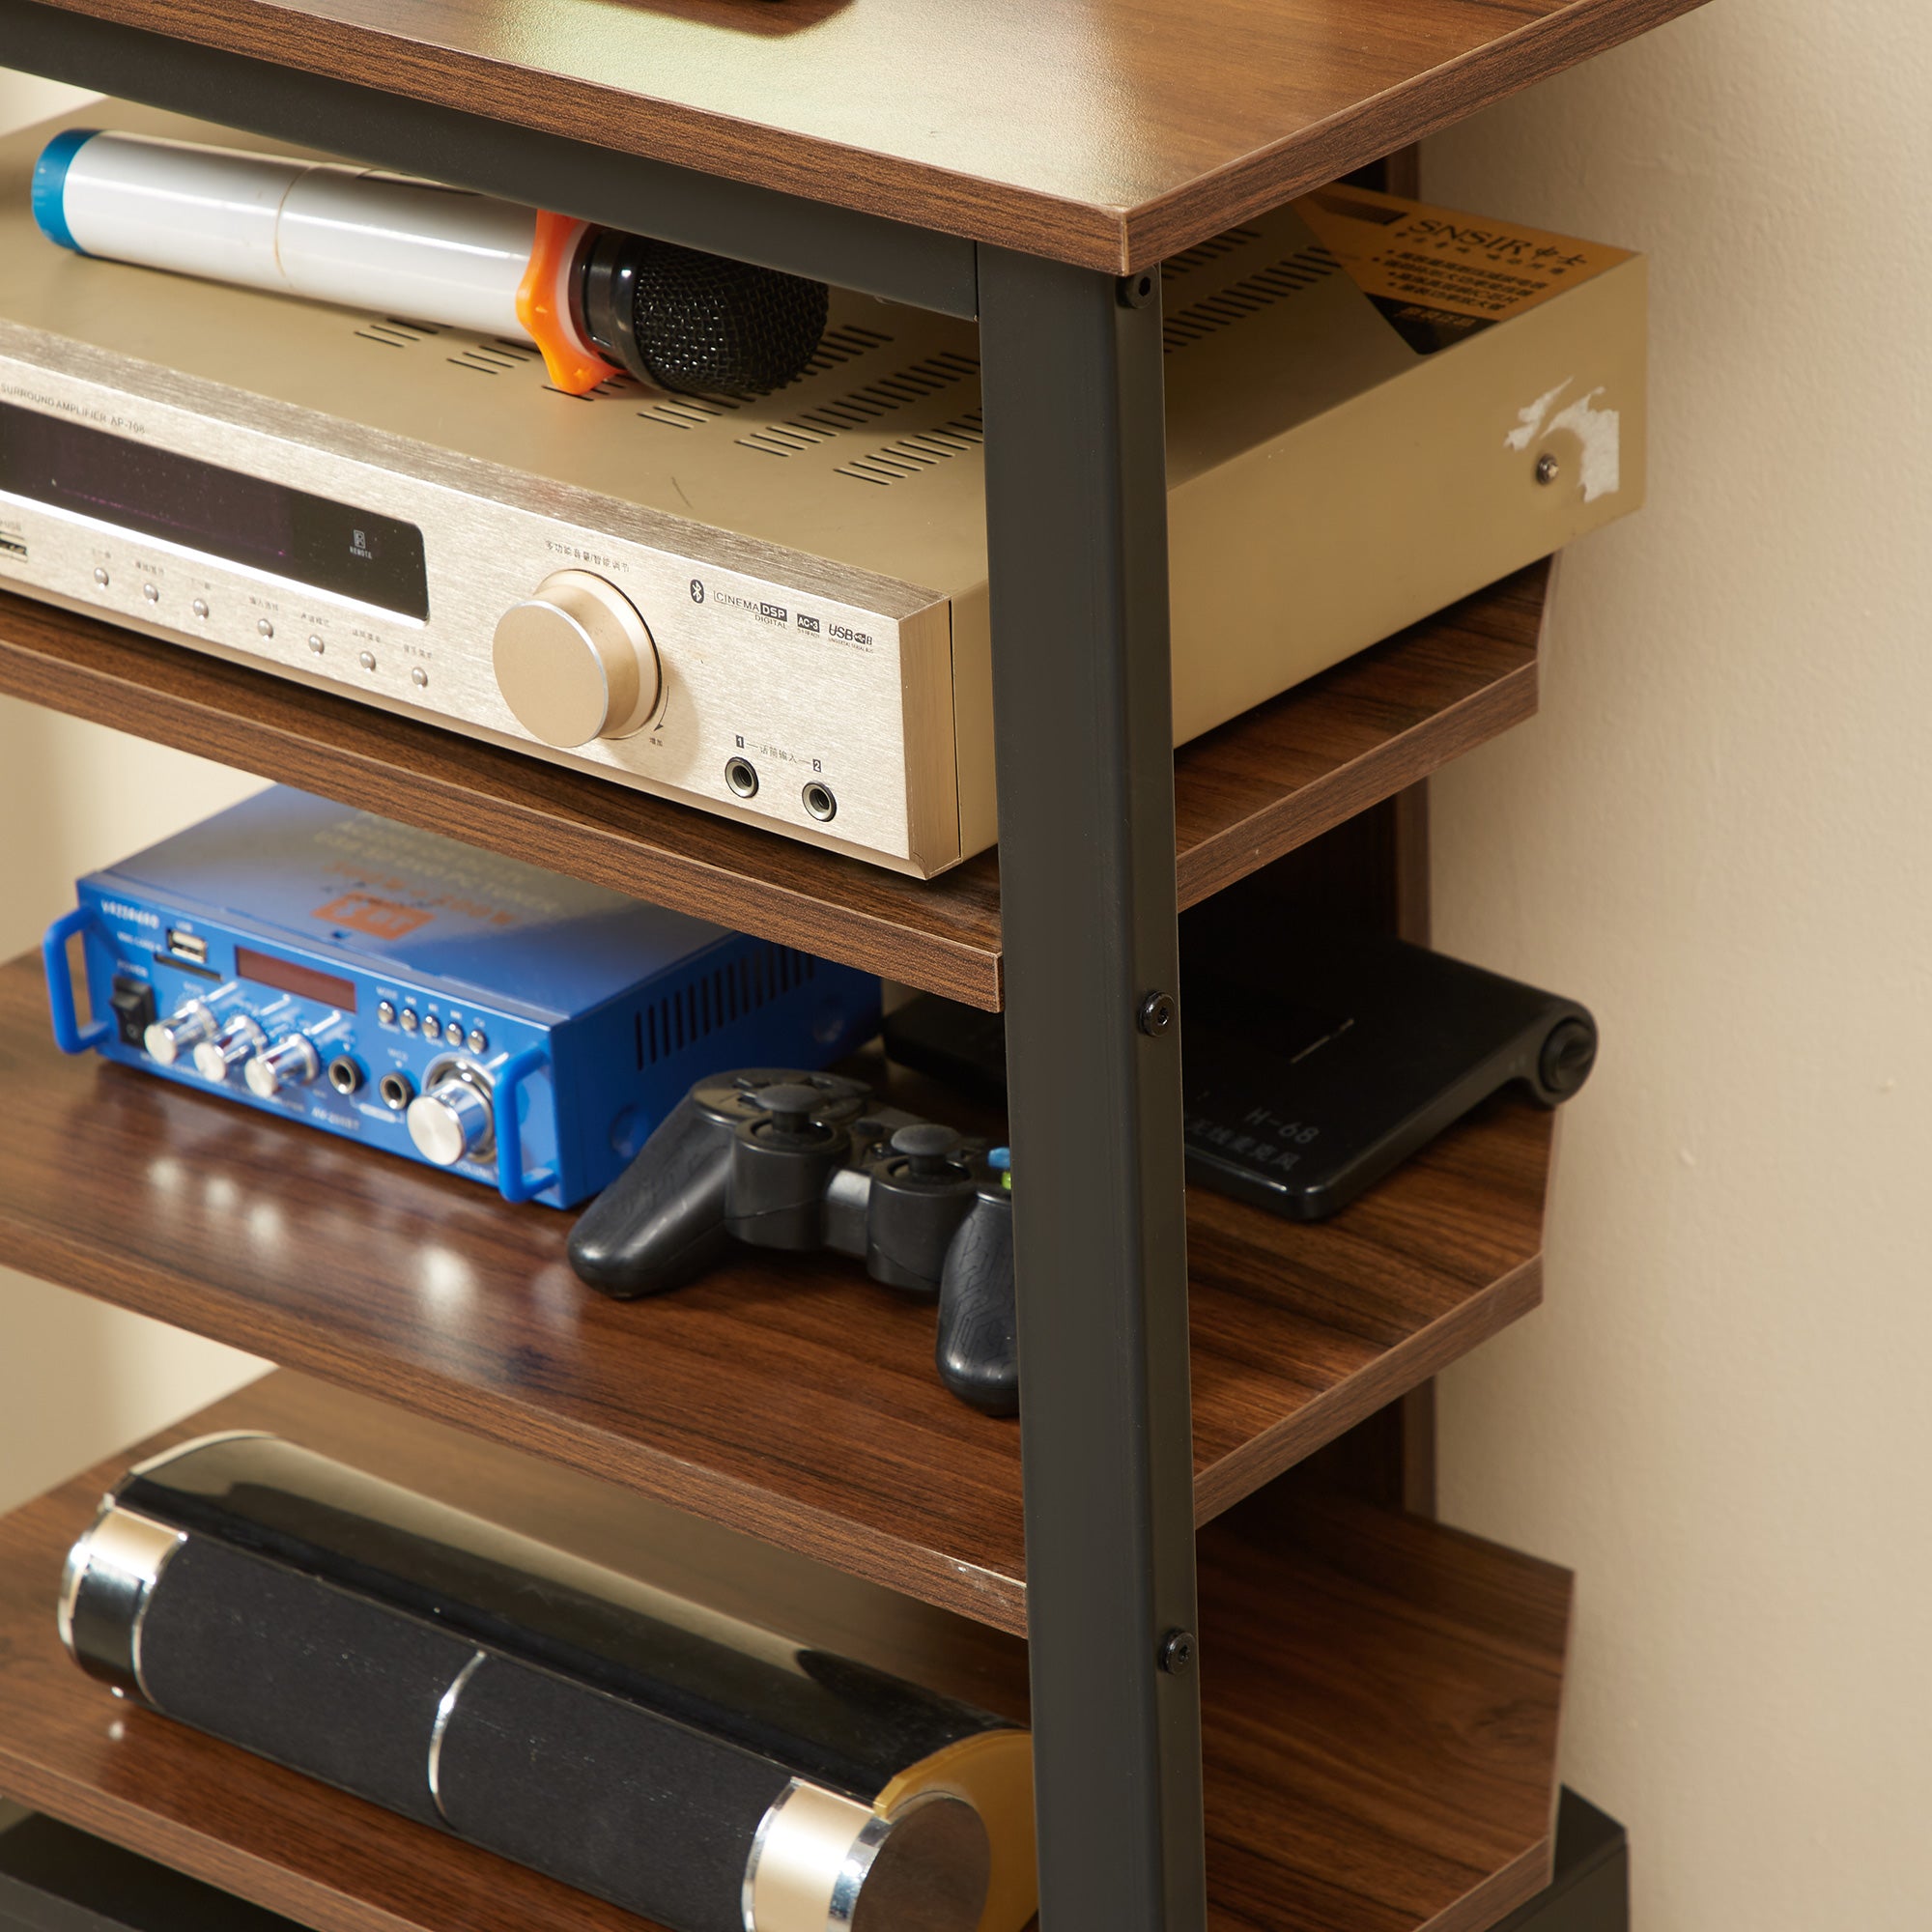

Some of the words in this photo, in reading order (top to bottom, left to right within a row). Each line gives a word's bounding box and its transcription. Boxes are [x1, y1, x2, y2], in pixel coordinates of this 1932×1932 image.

[1408, 219, 1532, 255] SNSIR
[0, 383, 54, 407] SURROUND
[56, 400, 107, 422] AMPLIFIER
[716, 591, 760, 612] CINEMA
[760, 602, 787, 622] DSP
[754, 613, 788, 630] DIGITAL
[797, 613, 819, 633] AC-3
[828, 623, 853, 640] USB
[1243, 1106, 1321, 1144] H-68
